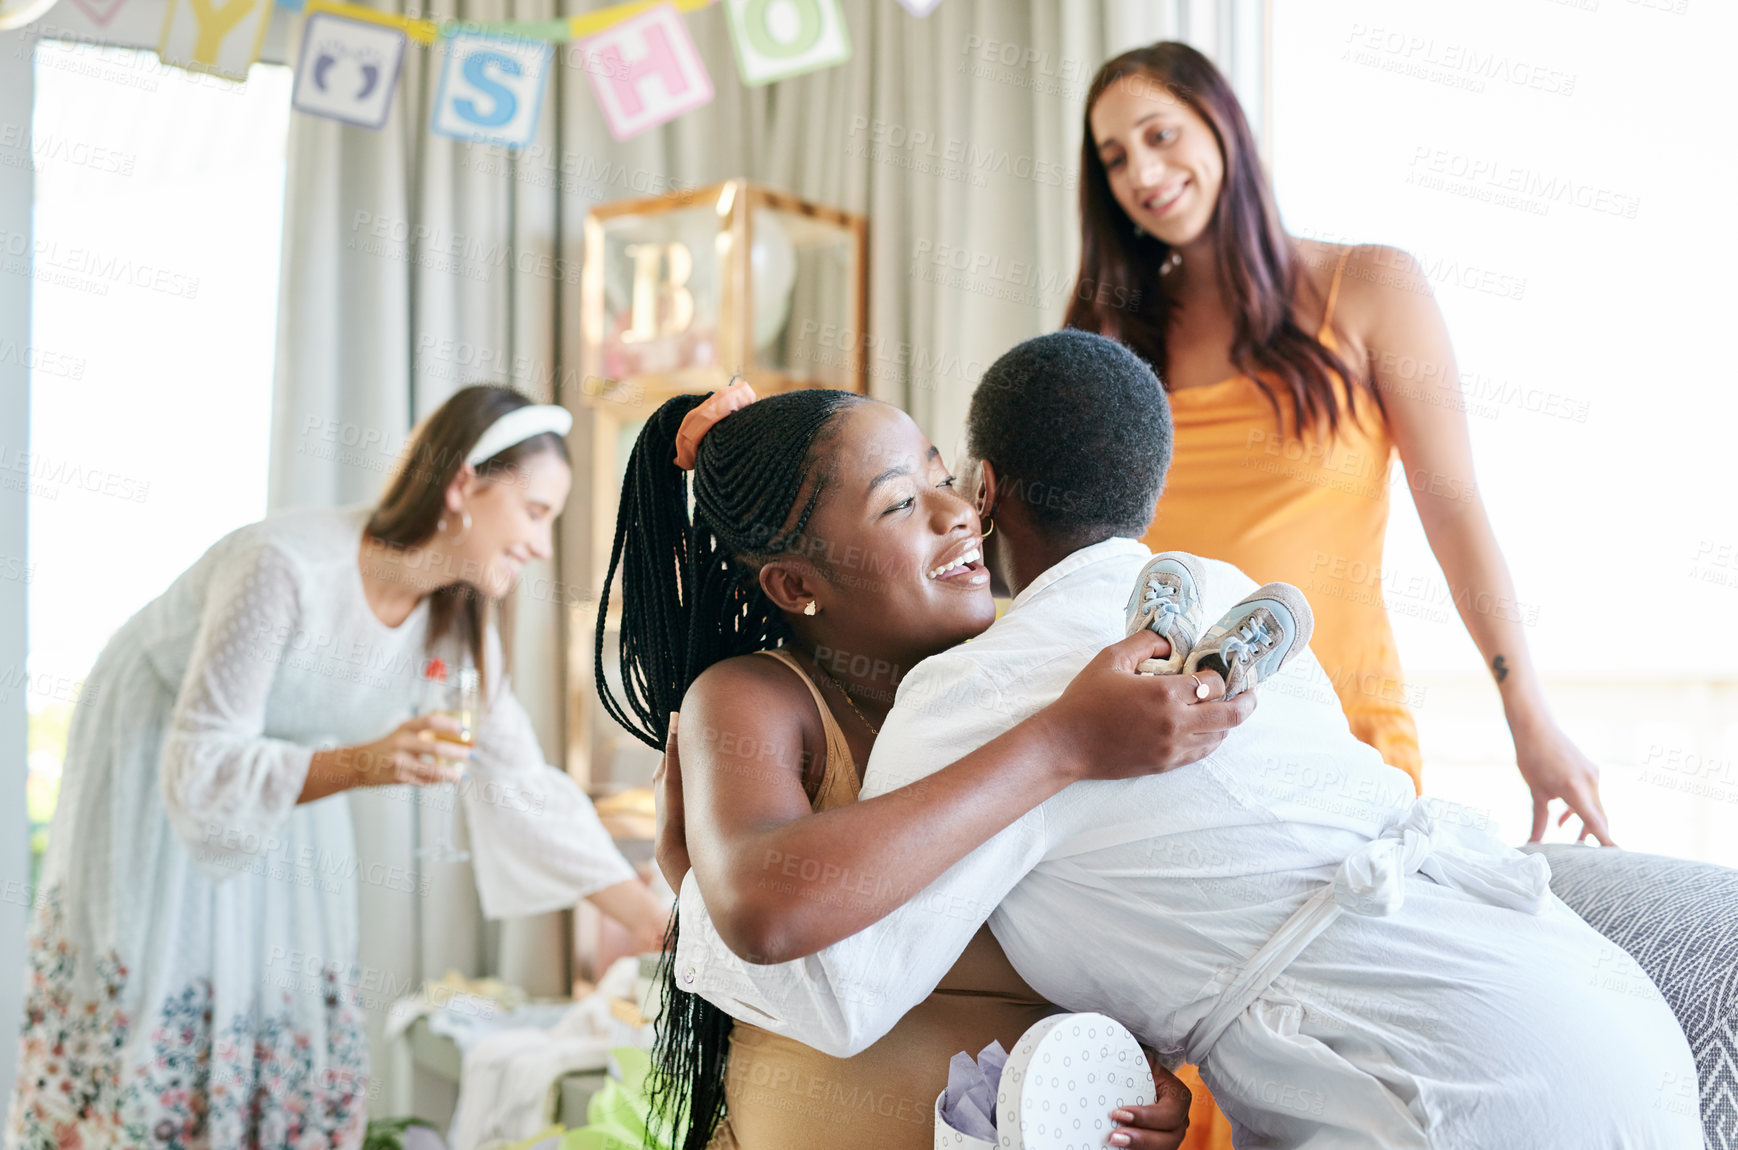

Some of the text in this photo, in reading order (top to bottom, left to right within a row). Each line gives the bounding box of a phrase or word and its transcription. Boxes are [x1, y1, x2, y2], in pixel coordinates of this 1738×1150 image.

[452, 51, 521, 127] S
[599, 22, 690, 118] H
[621, 242, 694, 343] B
